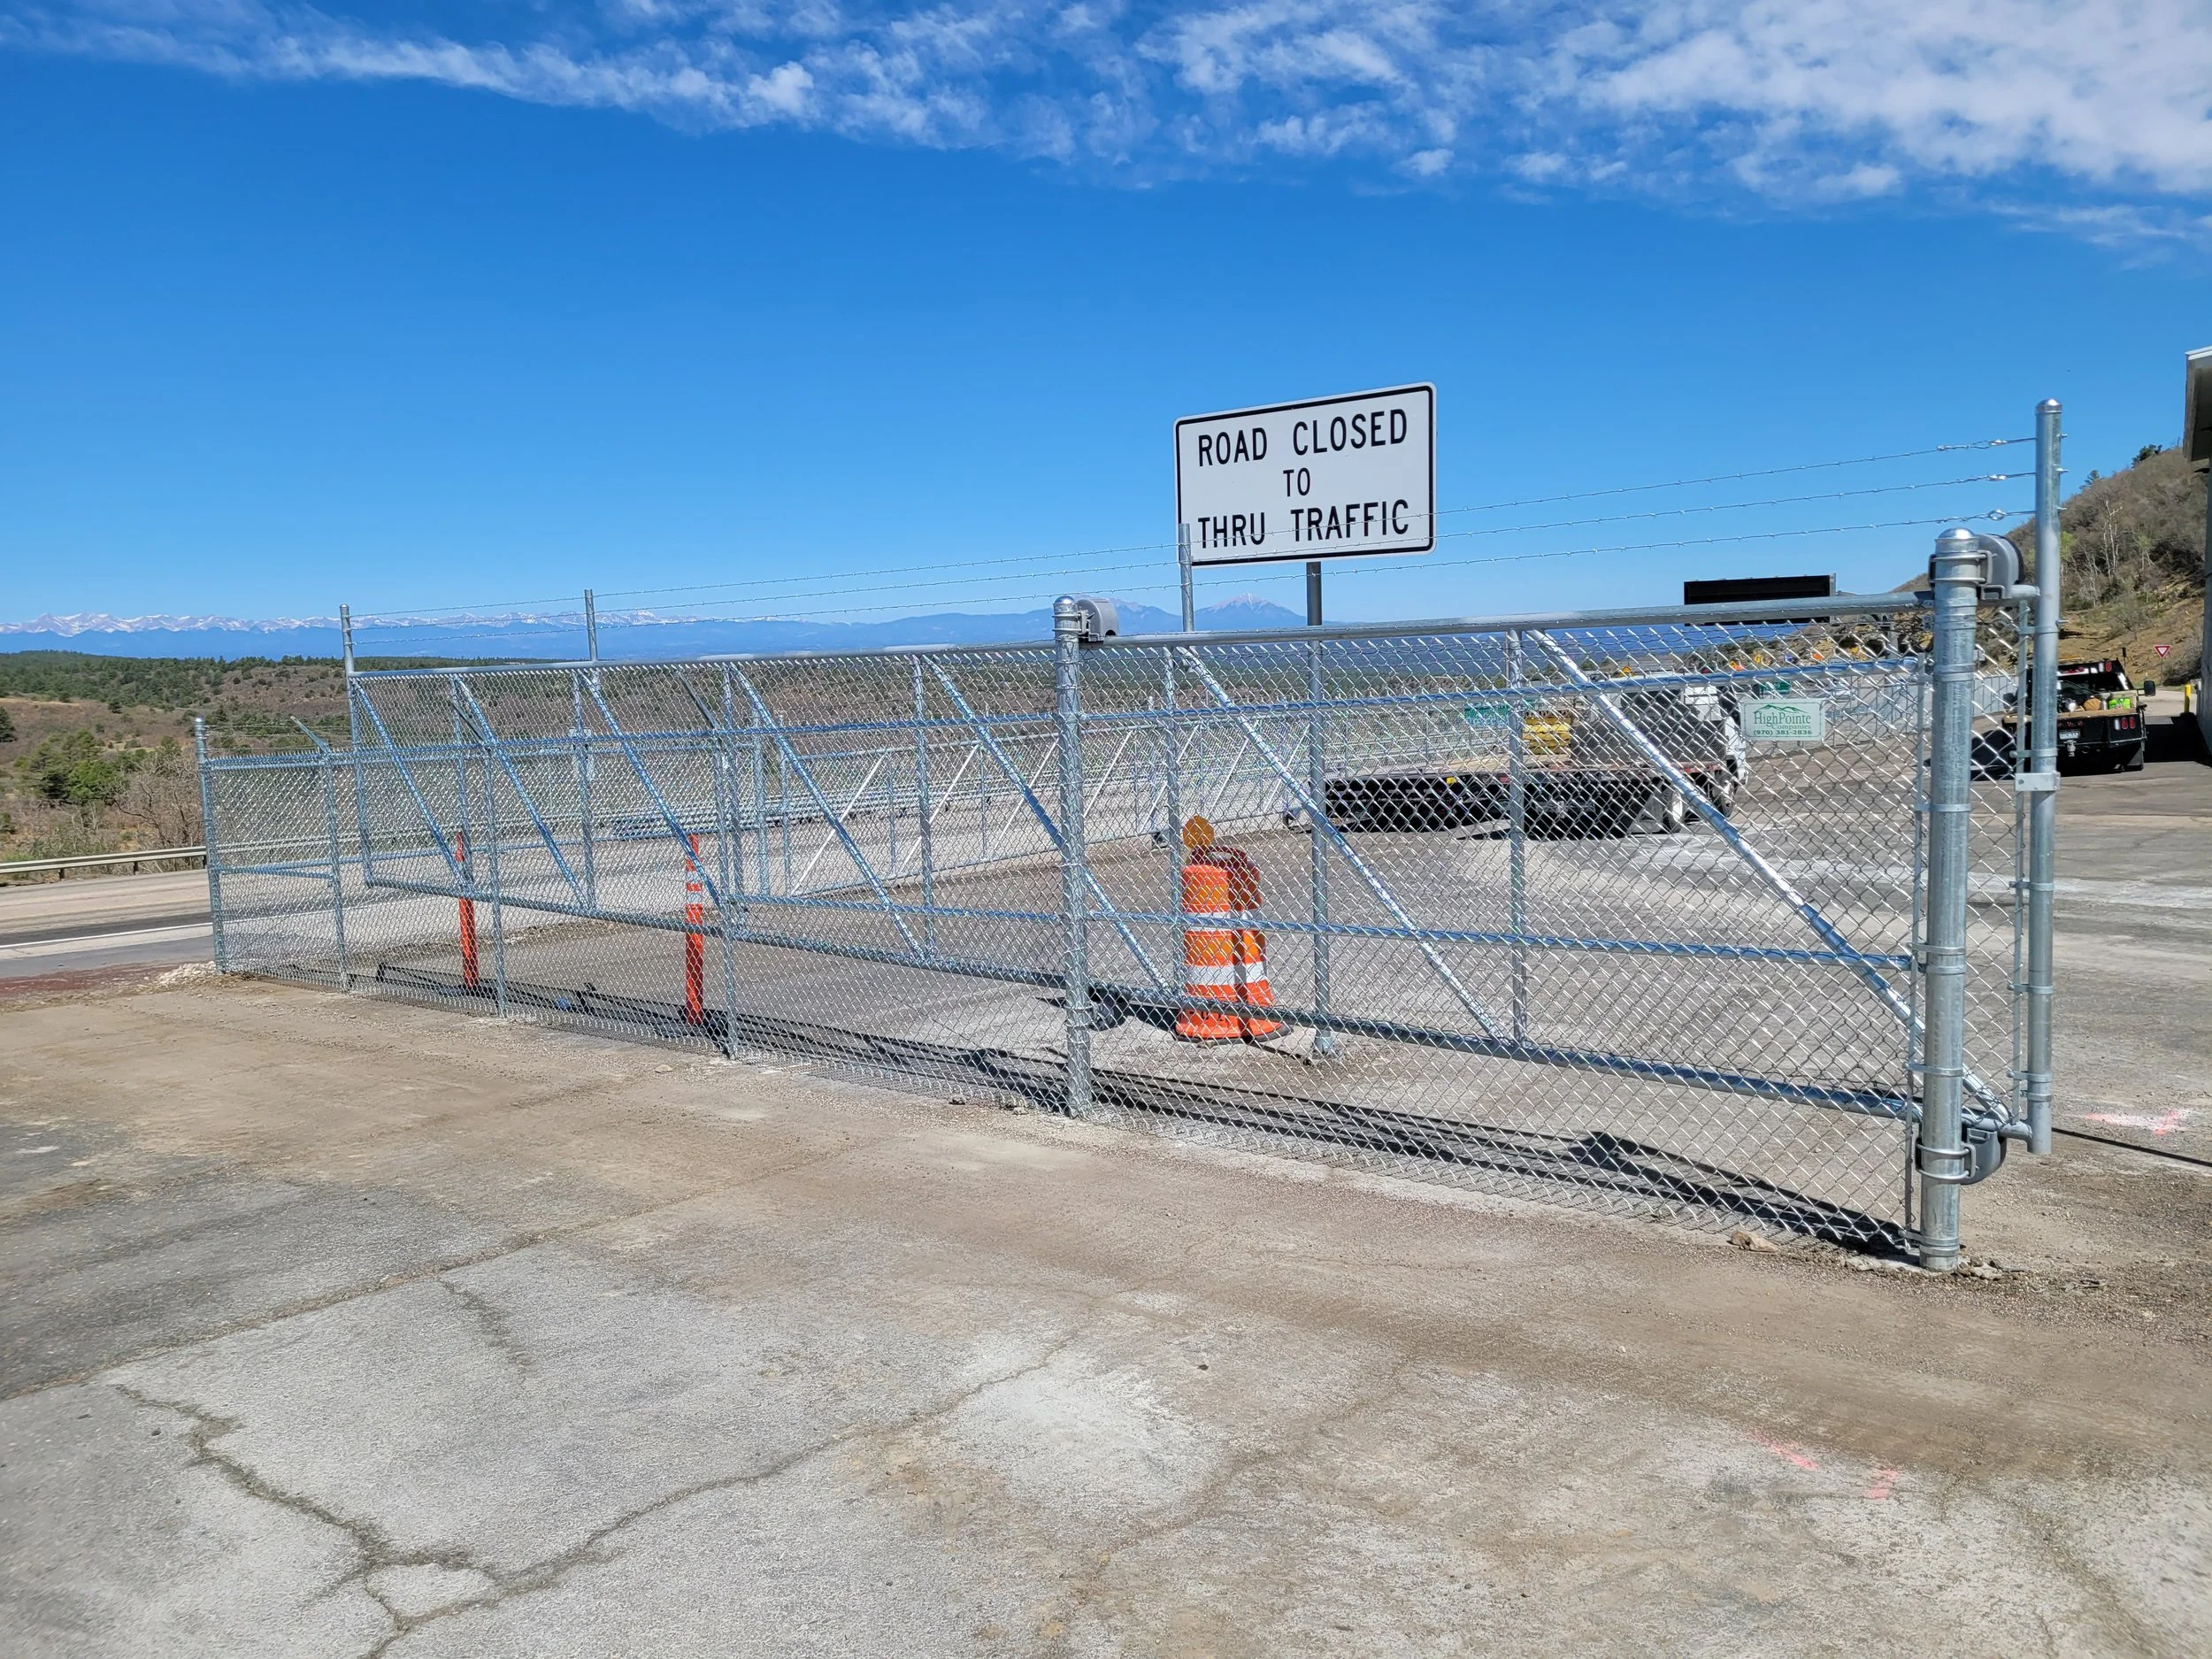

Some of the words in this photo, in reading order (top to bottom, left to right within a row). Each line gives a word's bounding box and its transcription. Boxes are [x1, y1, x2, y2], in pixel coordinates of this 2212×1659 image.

[1199, 427, 1267, 466] ROAD
[1293, 409, 1407, 455] CLOSED
[1283, 467, 1310, 496] TO
[1198, 512, 1265, 548] THRU
[1291, 499, 1409, 541] TRAFFIC
[1754, 710, 1811, 726] HighPointe
